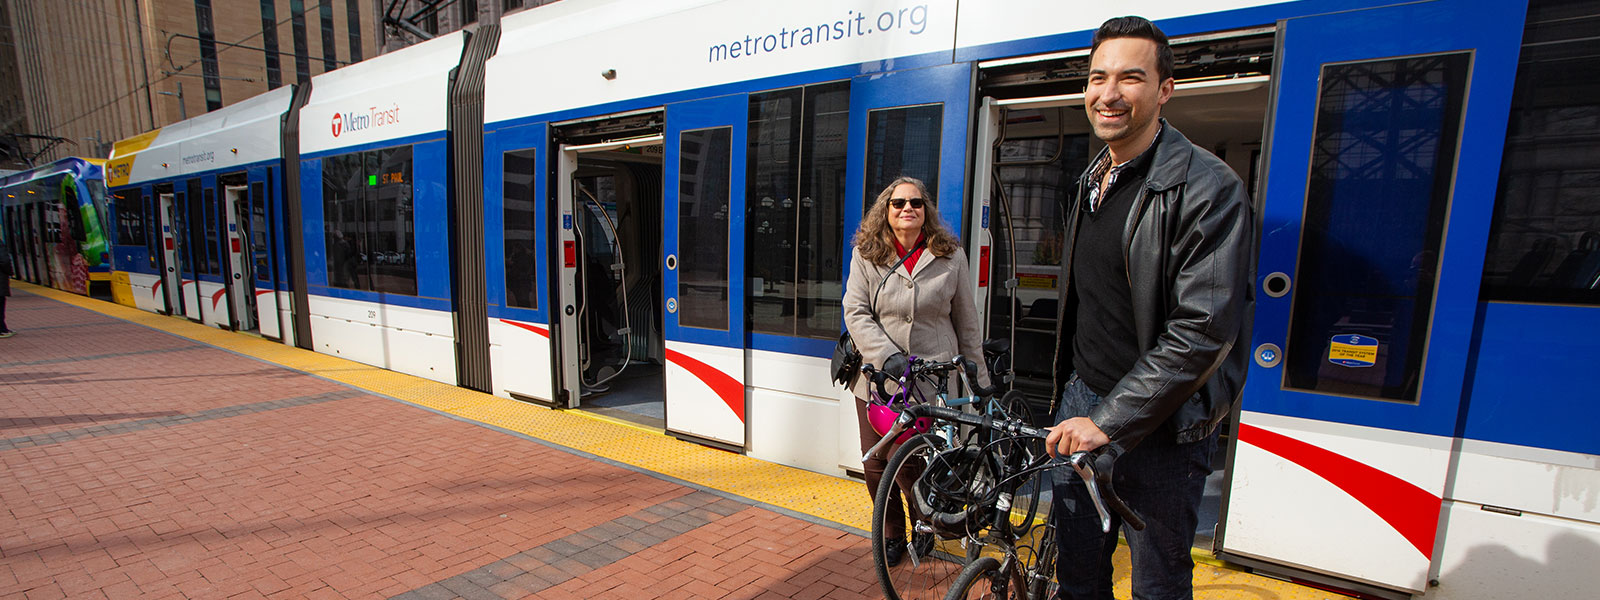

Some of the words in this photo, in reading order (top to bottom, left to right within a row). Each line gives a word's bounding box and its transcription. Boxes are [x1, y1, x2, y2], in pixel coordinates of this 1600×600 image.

[709, 4, 928, 63] metrotransit.org
[343, 112, 369, 133] Metro
[370, 103, 400, 128] Transit
[182, 151, 215, 165] metrotransit.org
[114, 163, 130, 178] METRO
[382, 173, 389, 184] ST
[390, 172, 404, 183] PAUL
